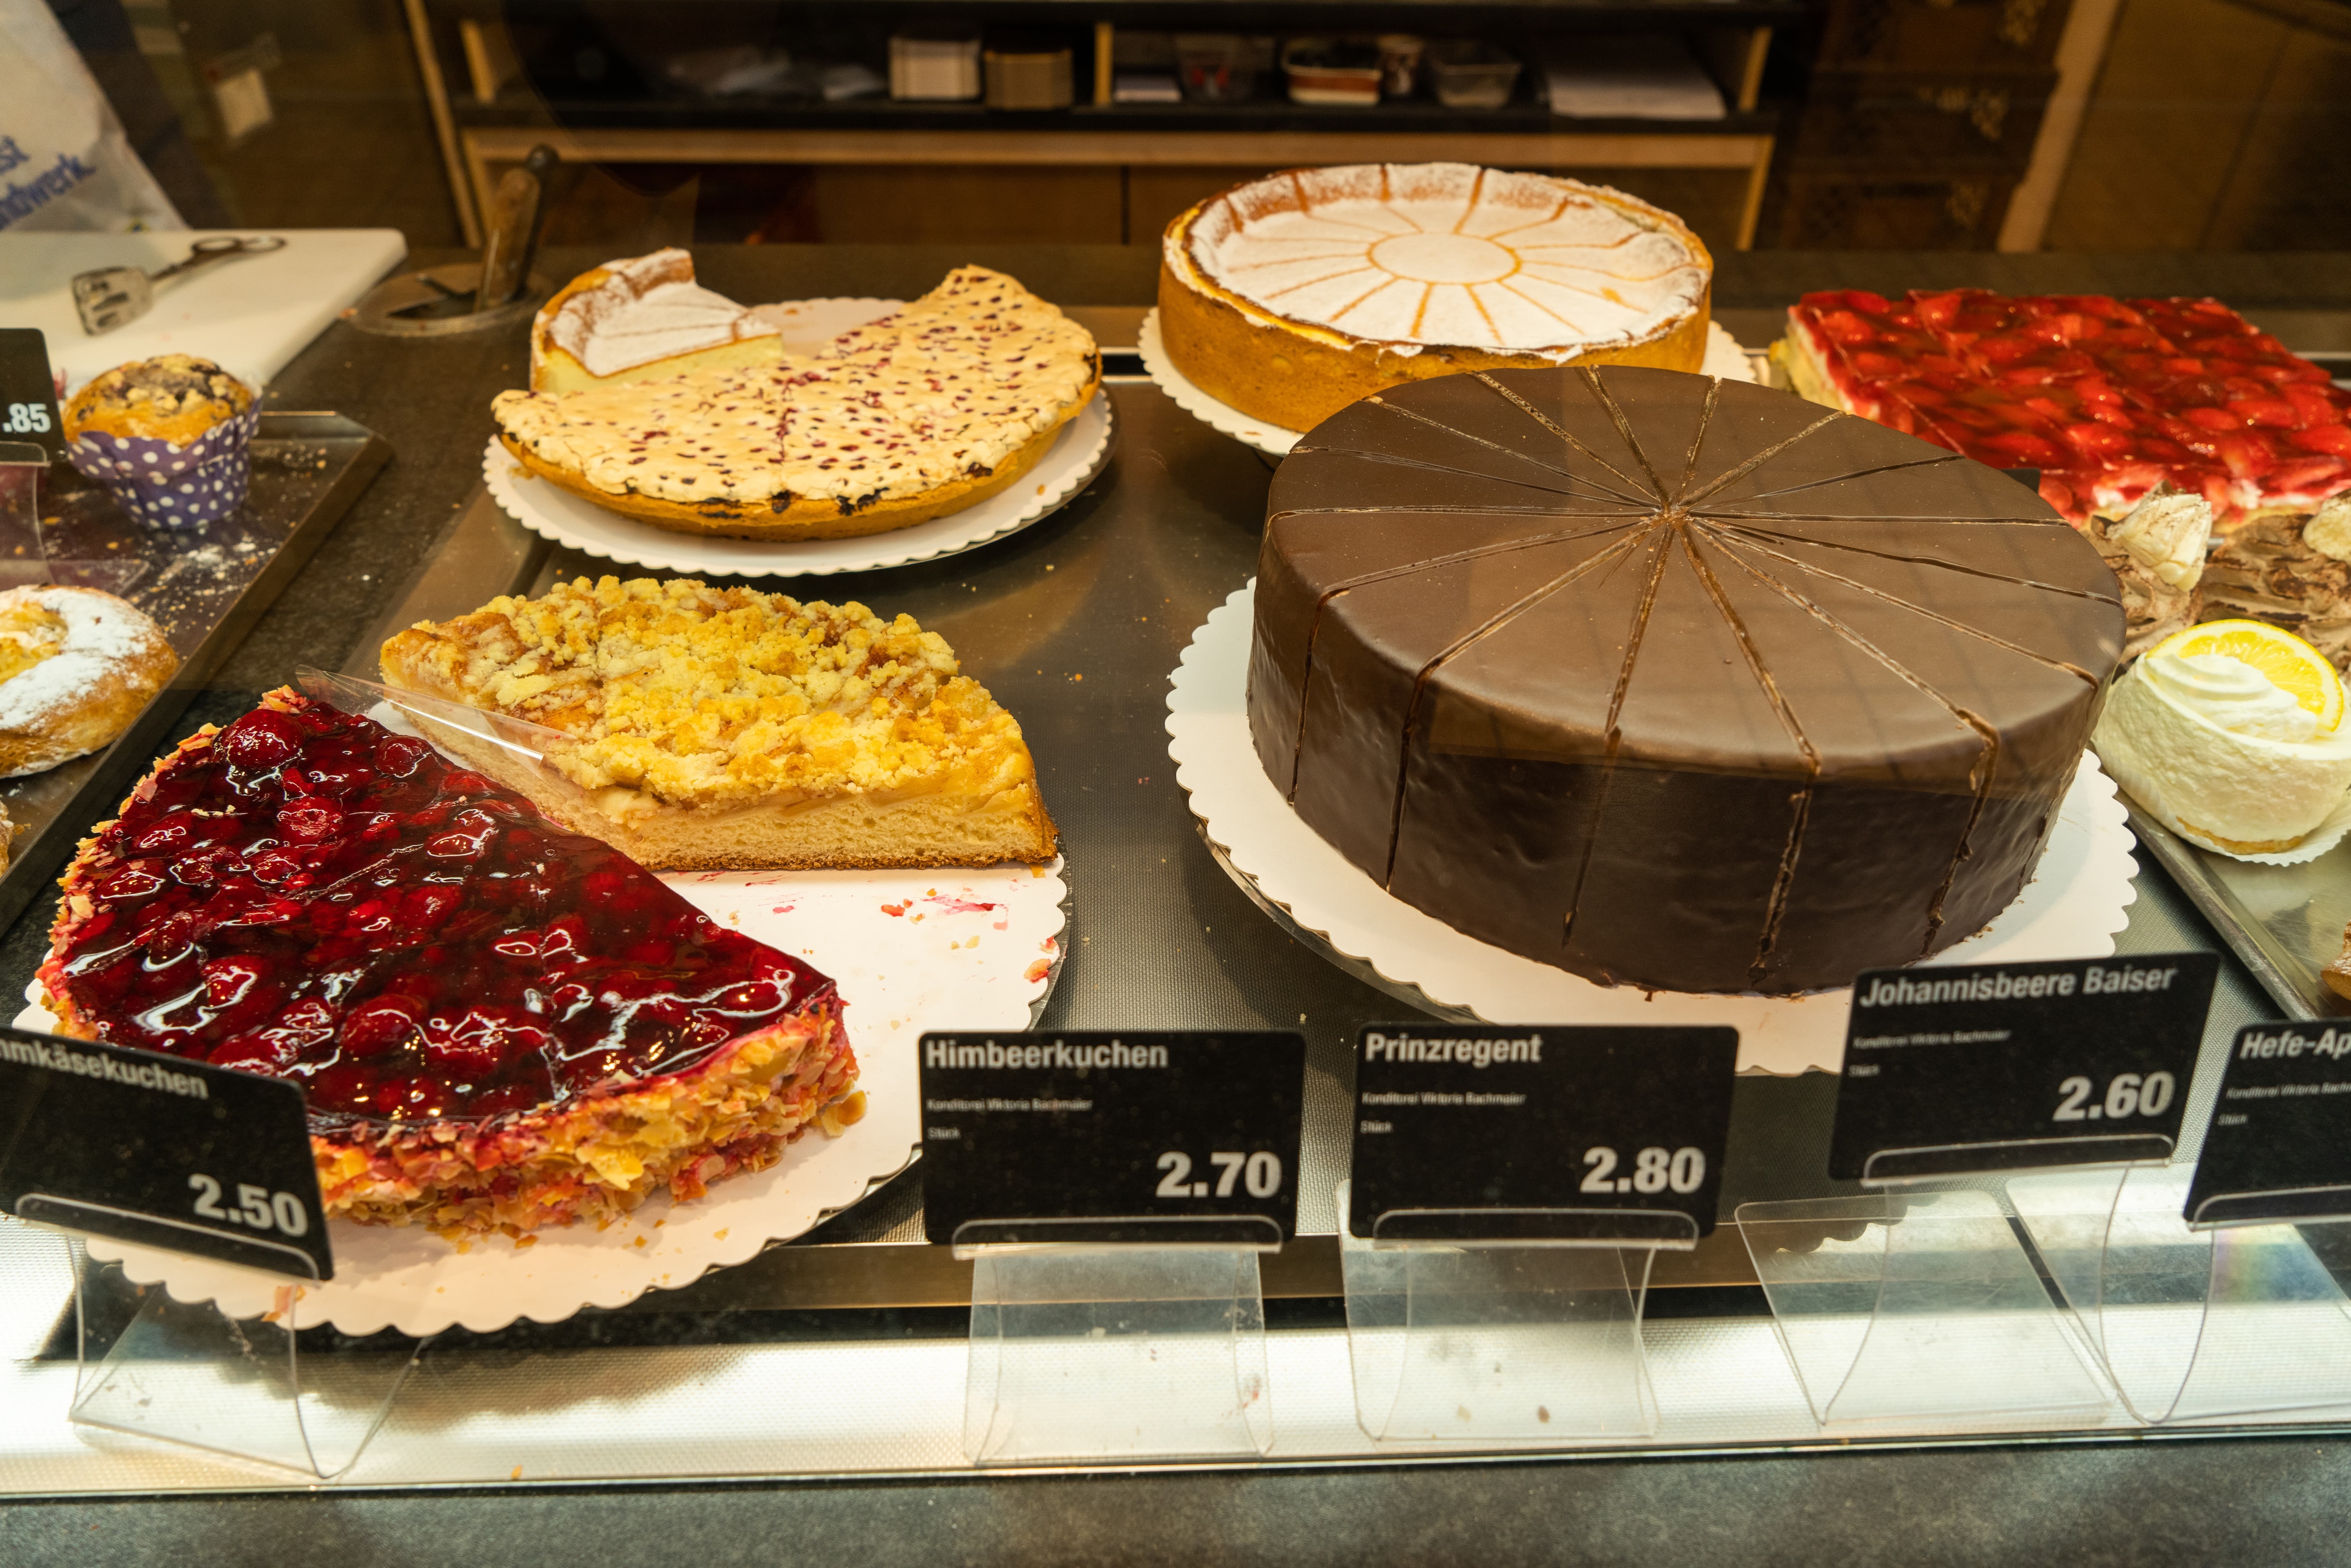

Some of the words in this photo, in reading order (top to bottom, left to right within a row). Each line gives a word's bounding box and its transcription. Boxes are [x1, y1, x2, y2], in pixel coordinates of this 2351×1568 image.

[1859, 971, 2075, 1007] Johannisbeere
[2082, 964, 2178, 993] Baiser
[925, 1039, 1168, 1069] Himbeerkuchen
[1365, 1032, 1542, 1068] Prinzregent
[2239, 1028, 2351, 1061] Hefe-Ap
[2052, 1071, 2175, 1122] 2.60
[927, 1127, 961, 1140] Stück
[1360, 1120, 1393, 1134] Stück
[1155, 1150, 1282, 1198] 2.70
[1579, 1146, 1706, 1194] 2.80
[188, 1173, 308, 1237] 2.50
